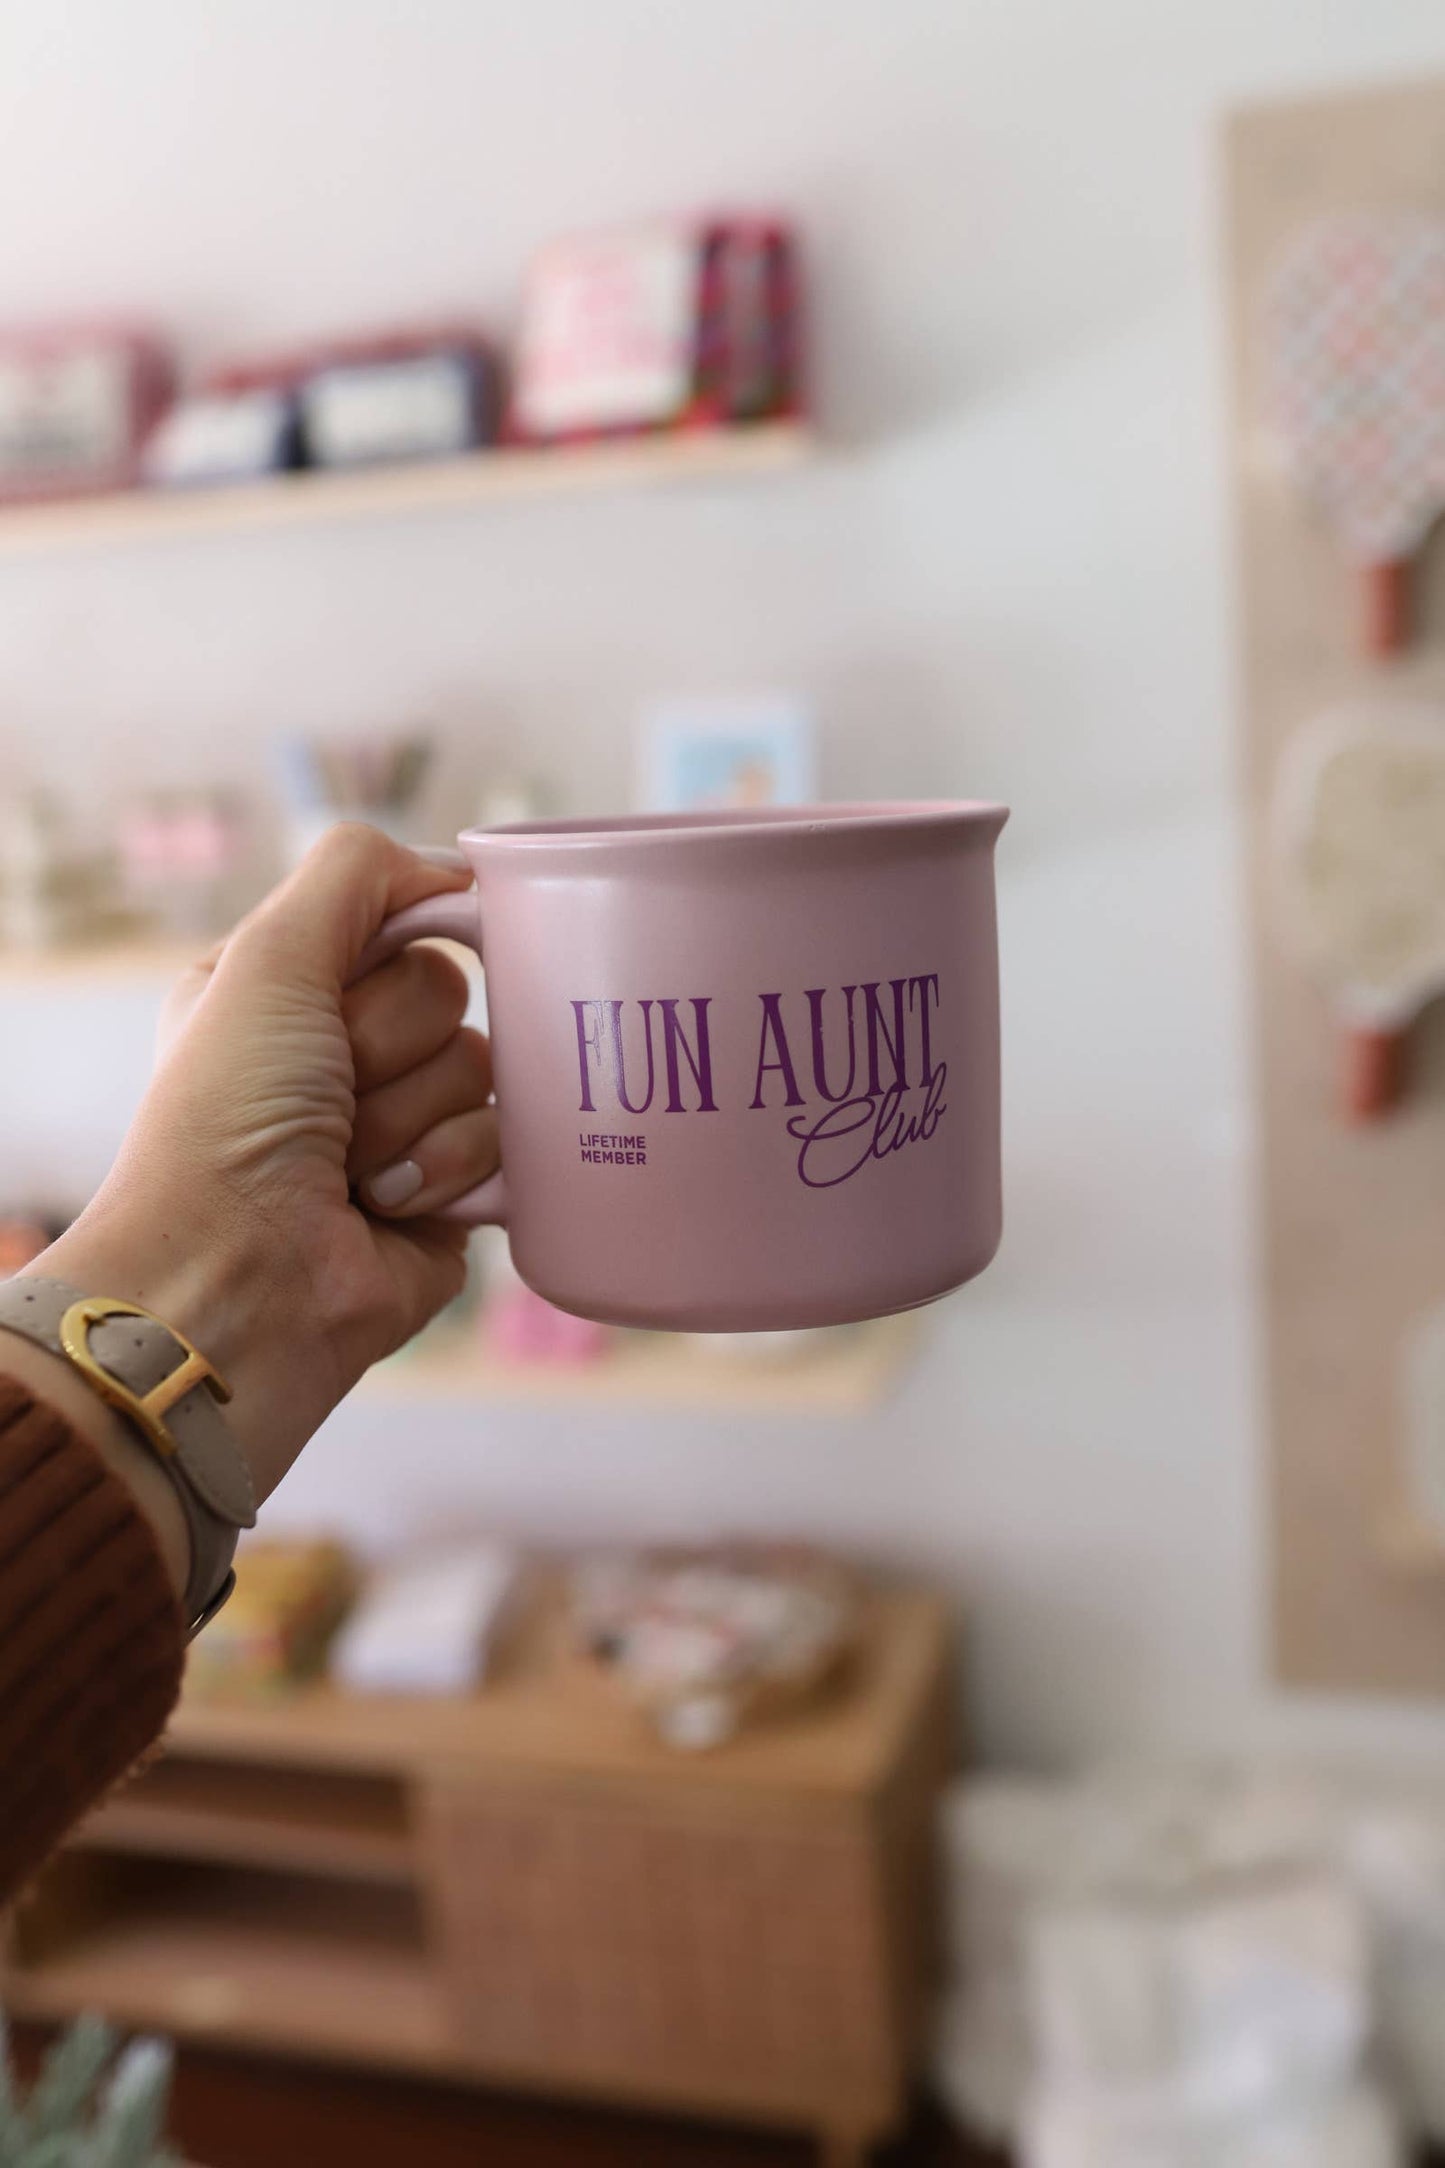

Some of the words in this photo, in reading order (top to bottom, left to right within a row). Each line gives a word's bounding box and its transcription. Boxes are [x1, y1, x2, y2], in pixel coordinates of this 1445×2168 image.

[570, 998, 720, 1114] FUN
[749, 974, 940, 1110] AUNT
[579, 1133, 647, 1149] LIFETIME
[581, 1149, 647, 1166] MEMBER
[786, 1062, 947, 1188] Club
